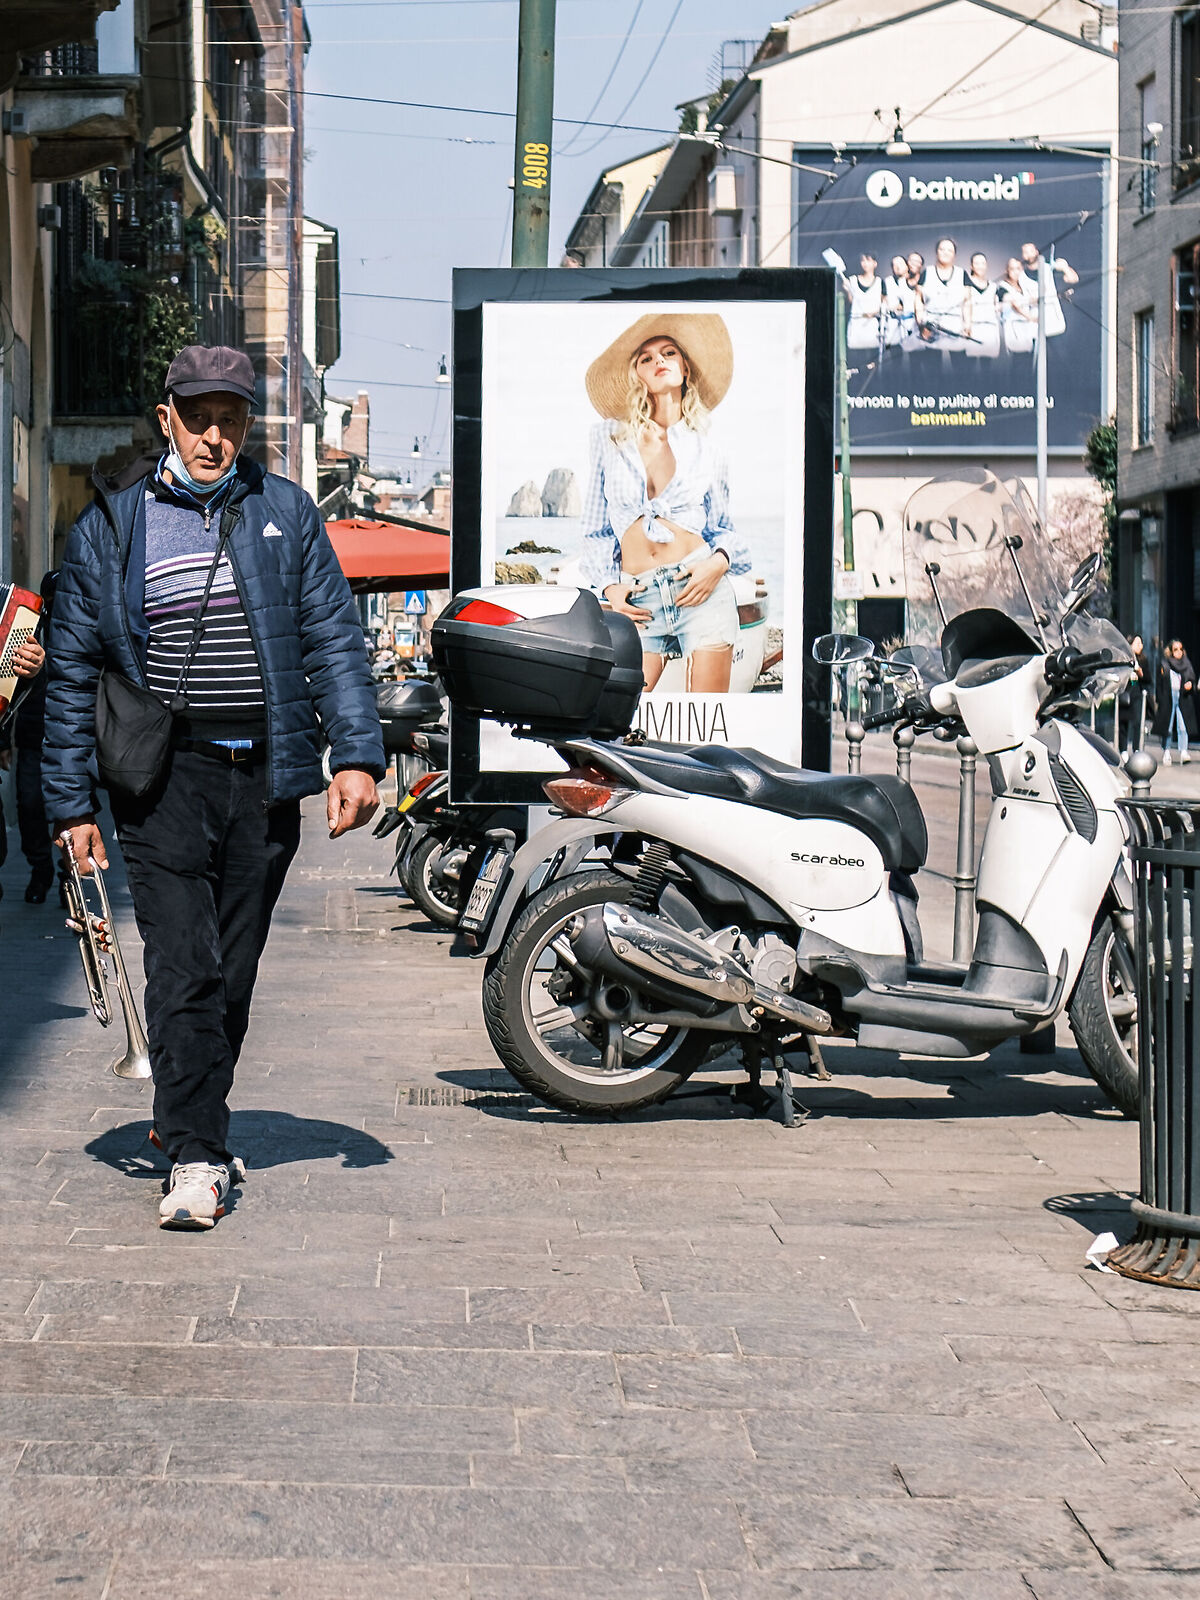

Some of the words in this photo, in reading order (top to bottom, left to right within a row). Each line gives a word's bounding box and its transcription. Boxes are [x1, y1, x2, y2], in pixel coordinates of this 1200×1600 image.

[522, 142, 549, 189] 4908
[908, 173, 1020, 201] batmaid
[846, 394, 894, 409] renota
[897, 394, 910, 409] le
[913, 395, 935, 409] tue
[938, 394, 981, 411] pulizie
[984, 394, 998, 409] di
[1000, 396, 1035, 409] casa
[910, 410, 986, 426] batmaid.it
[638, 702, 728, 742] MINA
[790, 852, 865, 867] scarabeo
